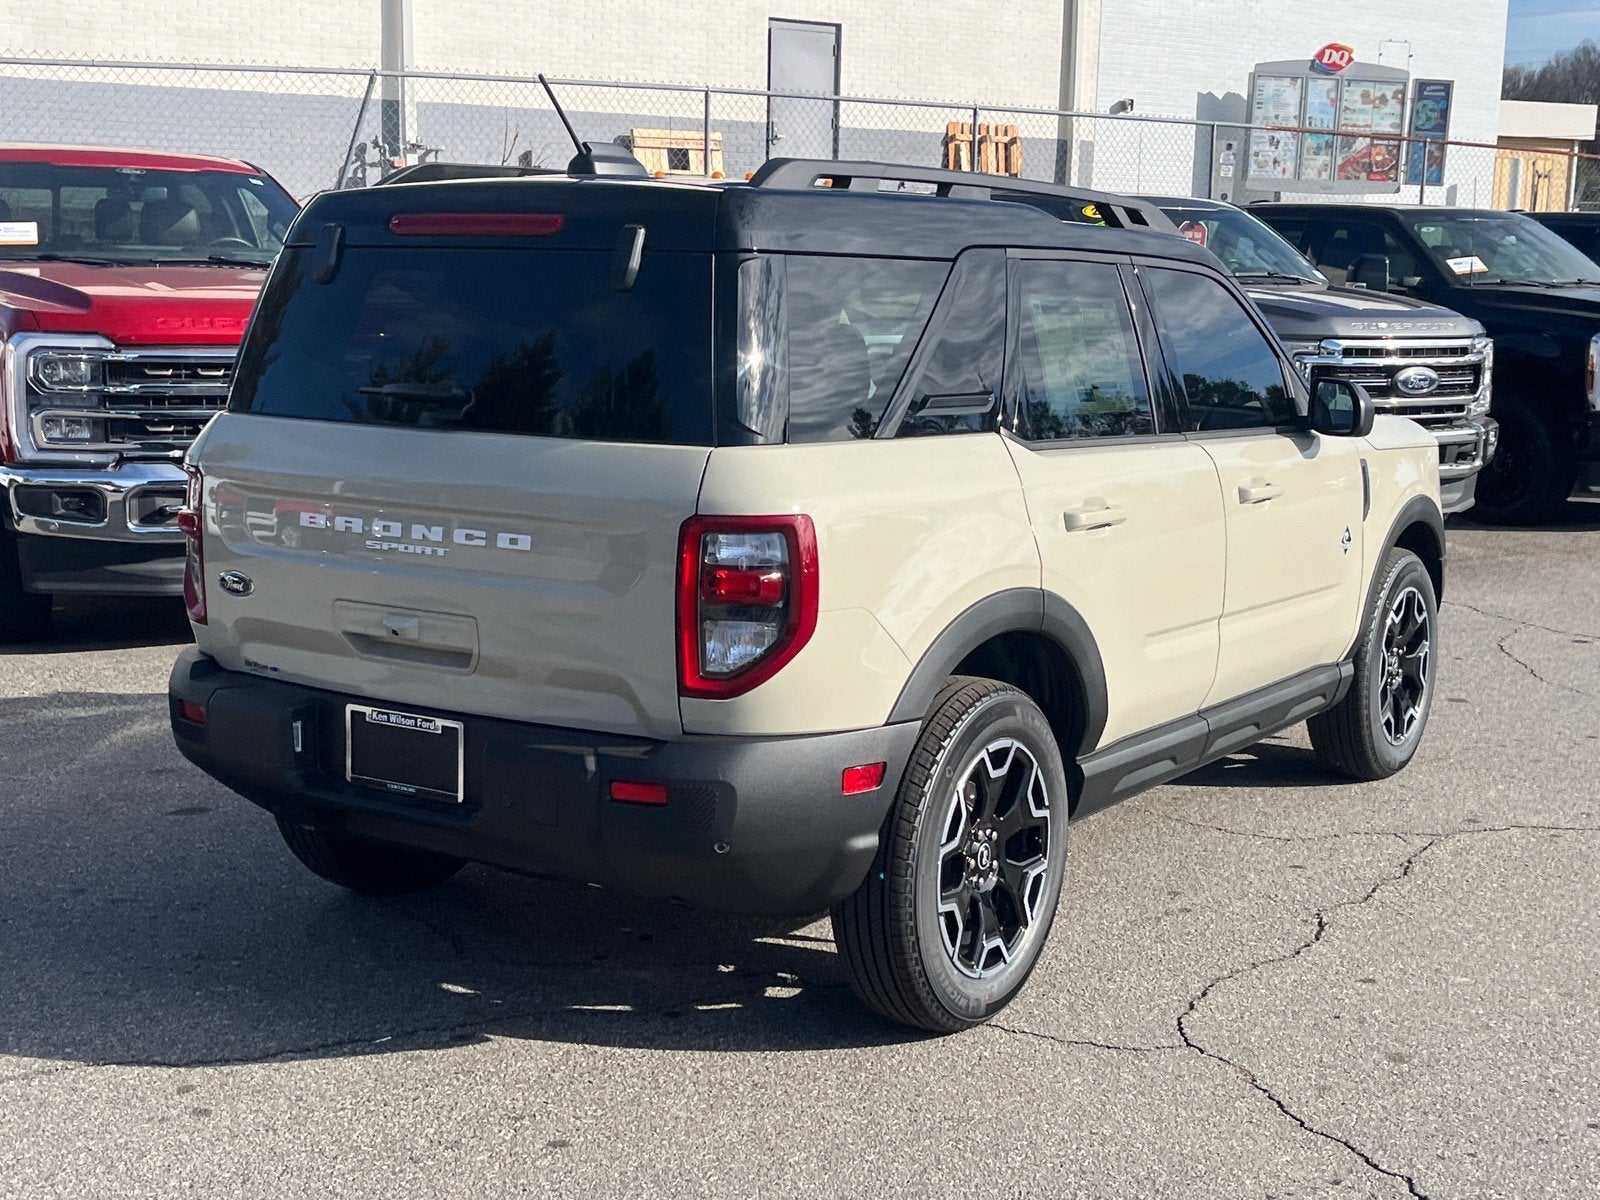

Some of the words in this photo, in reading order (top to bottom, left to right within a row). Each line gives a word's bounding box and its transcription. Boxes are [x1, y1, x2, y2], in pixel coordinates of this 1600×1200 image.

[1322, 48, 1349, 67] DQ
[299, 511, 532, 551] BRONCO
[365, 540, 449, 556] SPORT
[372, 710, 388, 722] Ken
[389, 713, 415, 727] Wilson
[417, 718, 435, 730] Ford
